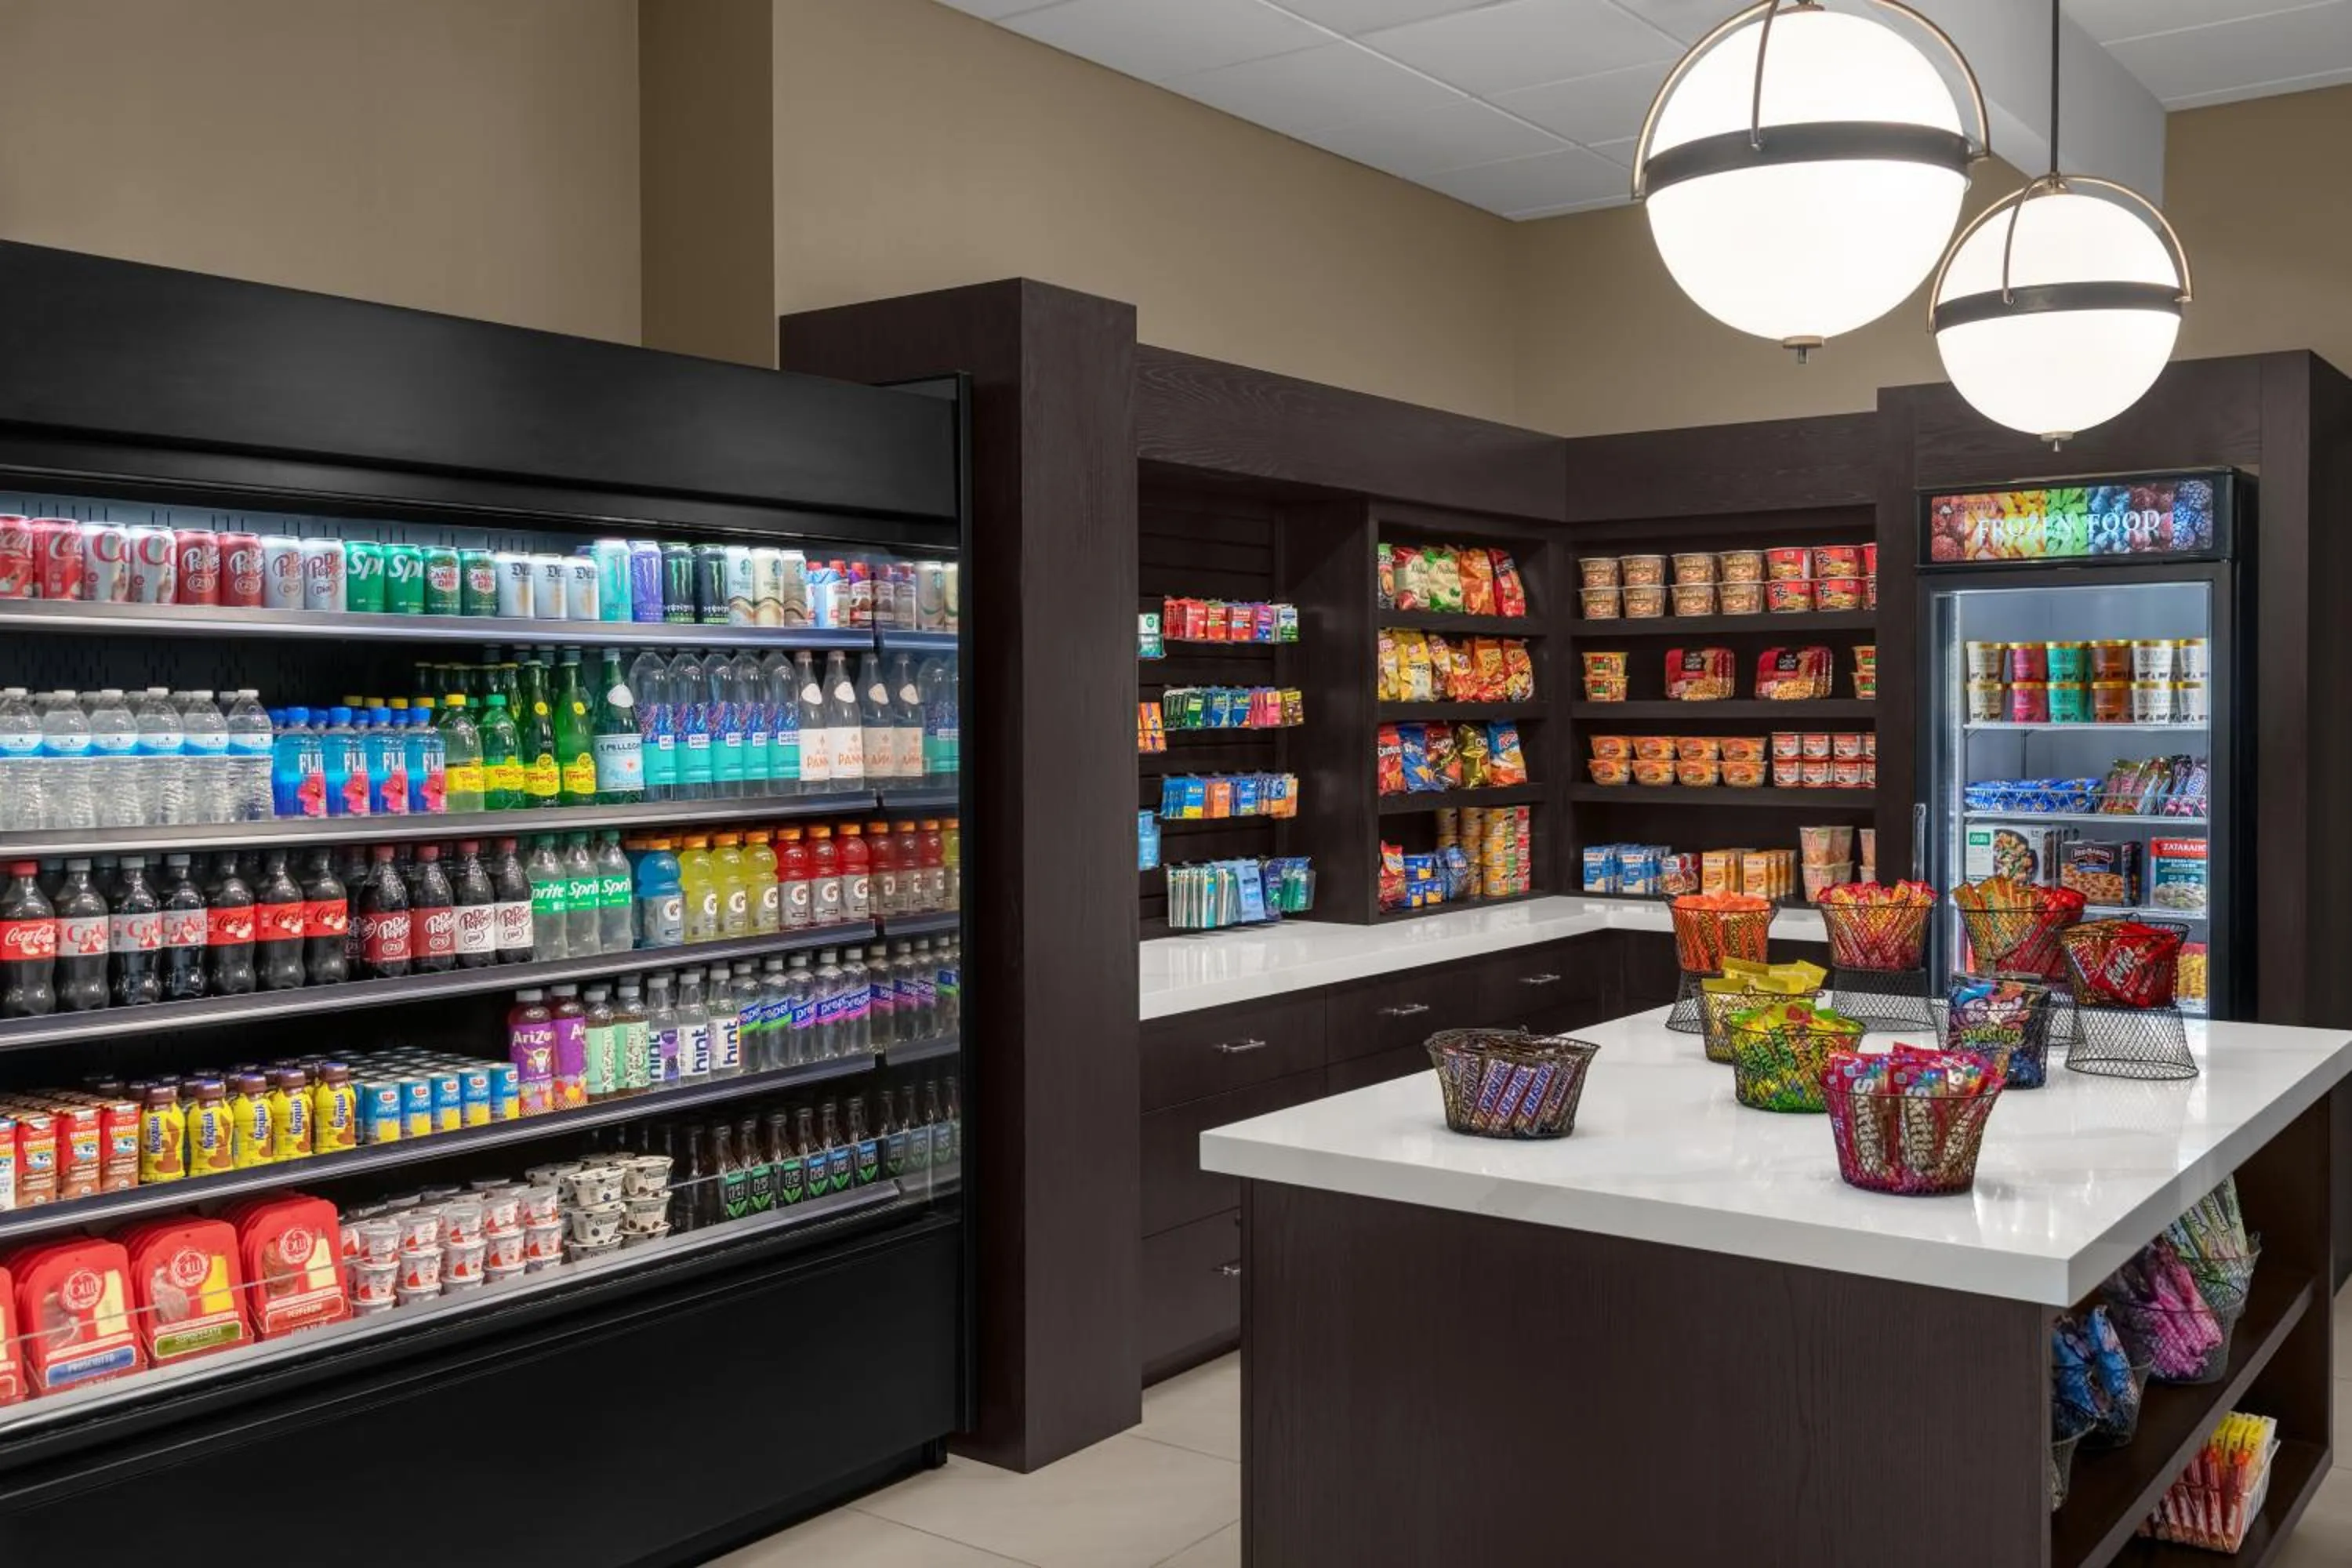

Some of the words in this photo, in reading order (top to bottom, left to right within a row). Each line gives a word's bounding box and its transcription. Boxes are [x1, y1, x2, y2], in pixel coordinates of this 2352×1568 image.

[1977, 514, 2077, 544] FROZEN
[2086, 510, 2162, 533] FOOD
[299, 753, 323, 773] FIJI
[344, 753, 367, 772] FIJI
[383, 753, 405, 771] FIJI
[423, 753, 445, 772] FIJI
[532, 884, 565, 900] prite
[791, 884, 807, 905] G
[822, 881, 839, 902] G
[692, 1029, 707, 1073] hint
[723, 1022, 738, 1065] hint
